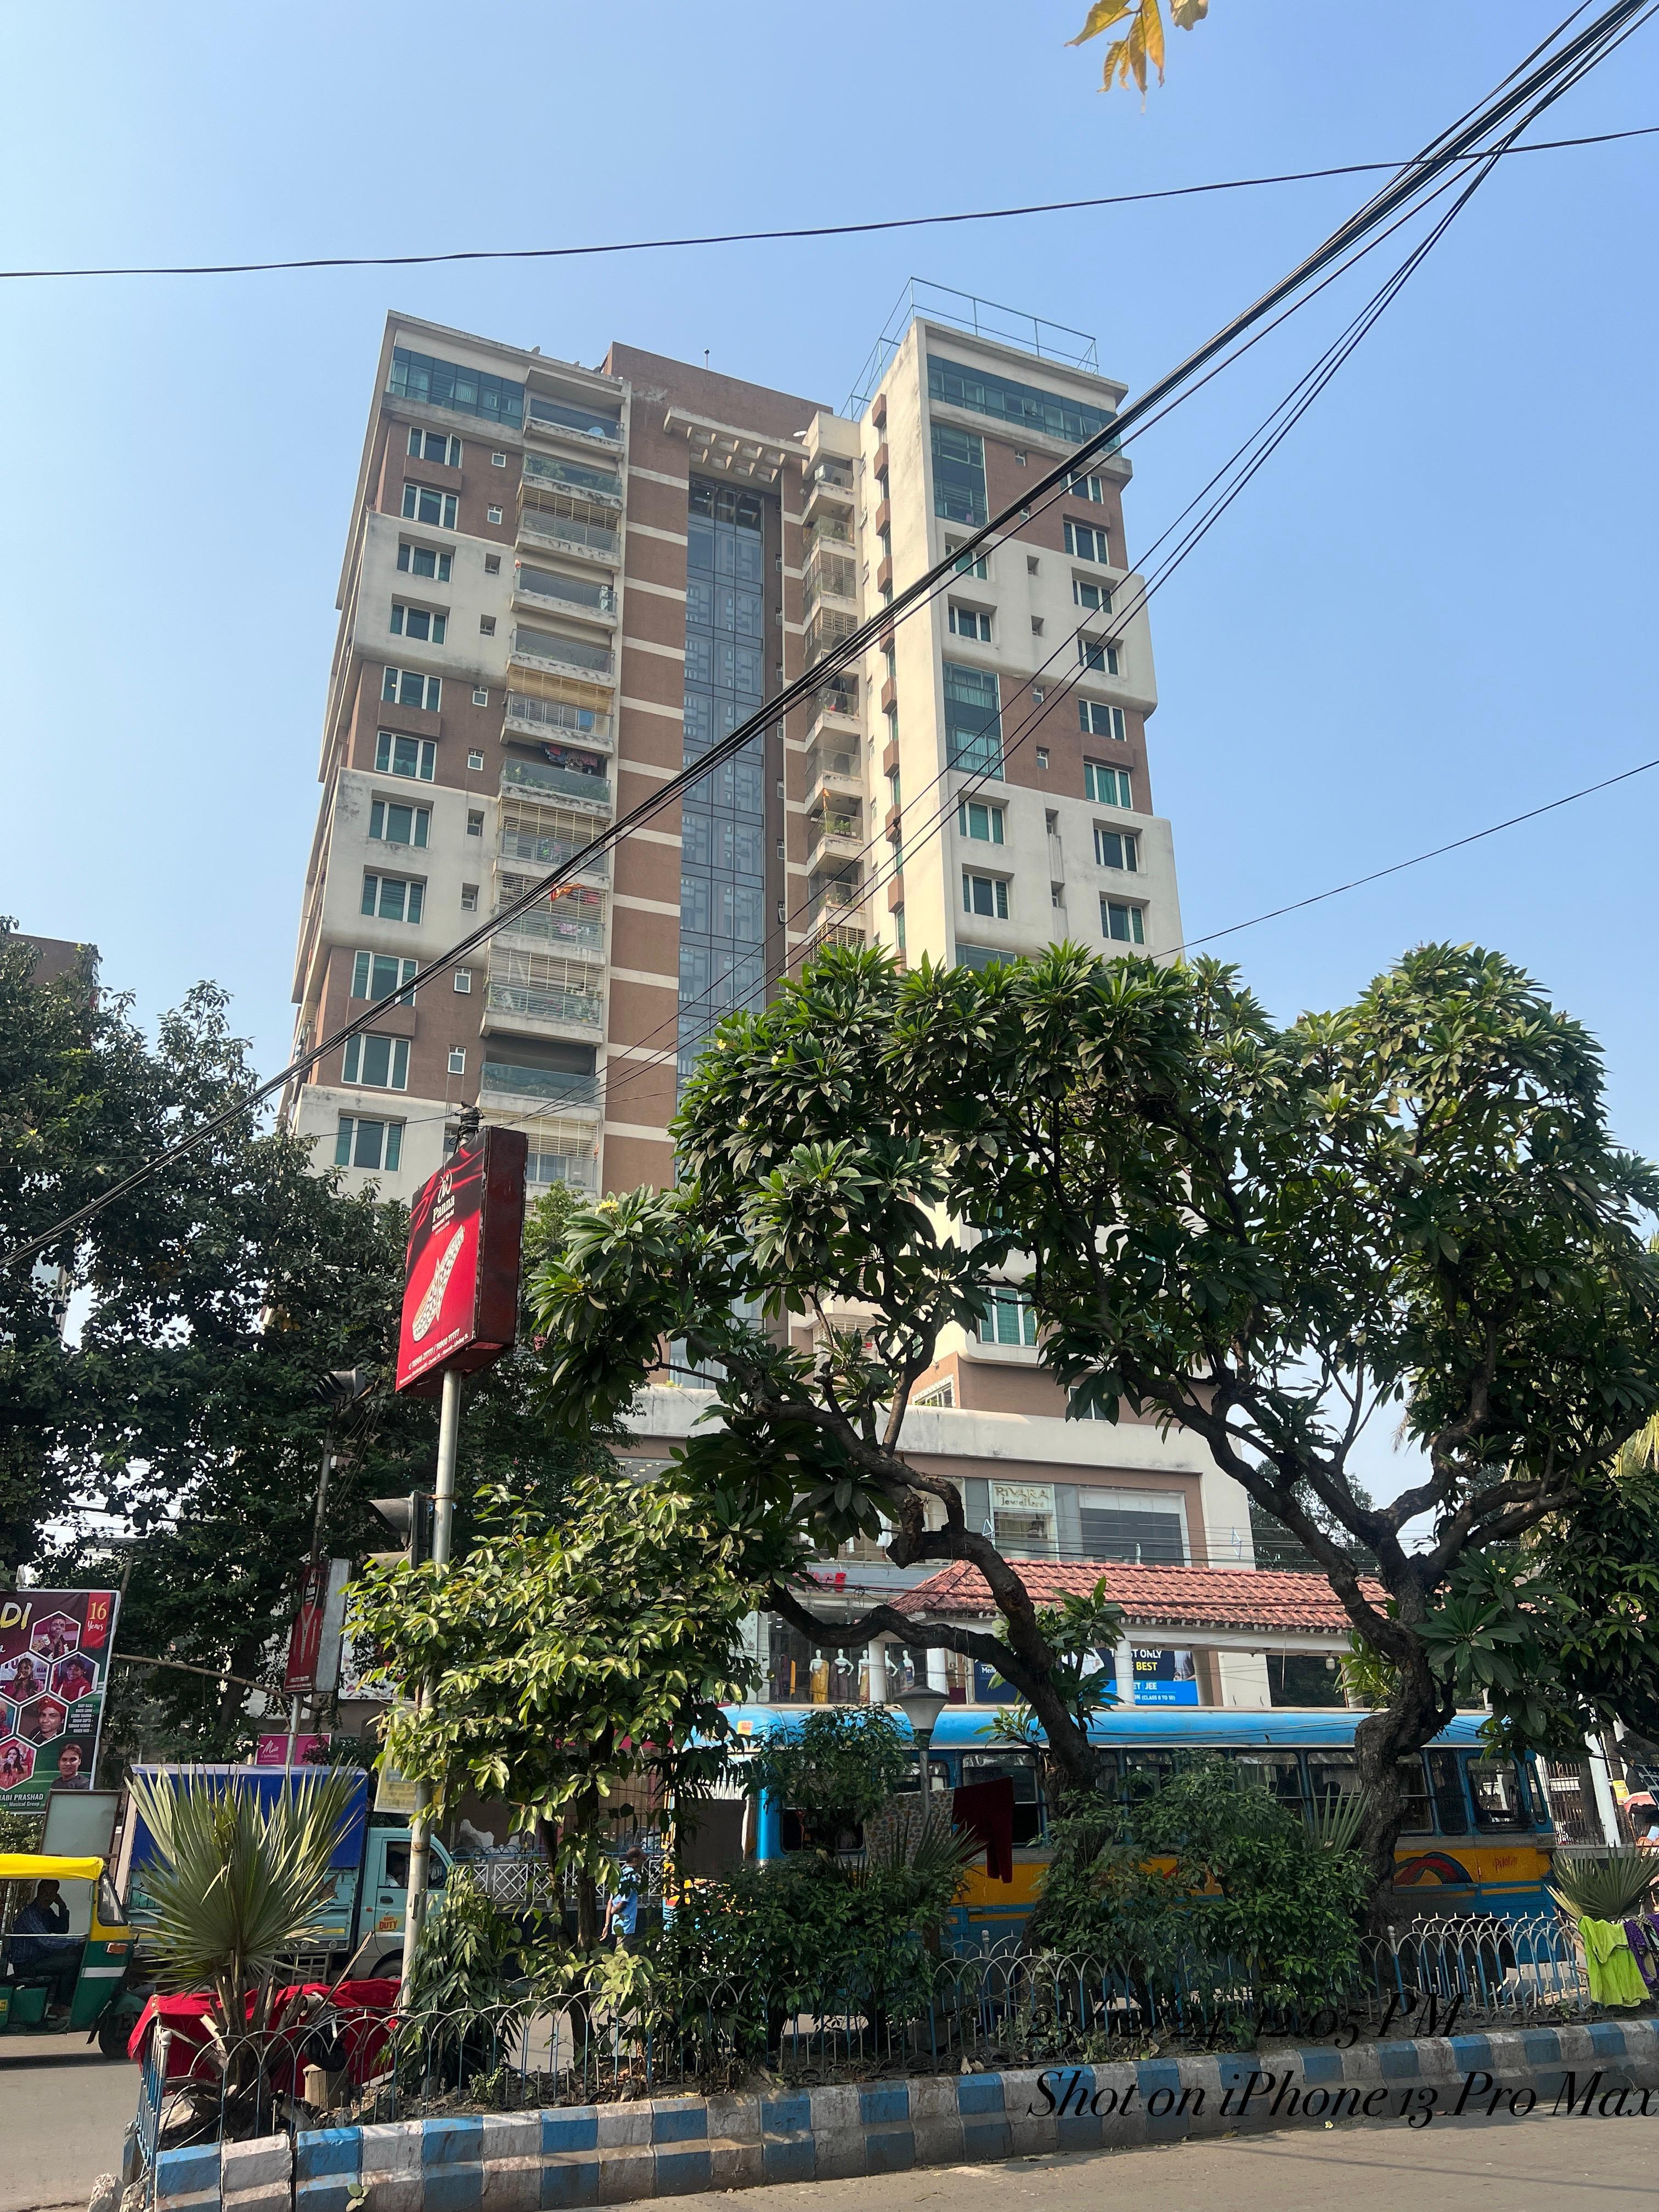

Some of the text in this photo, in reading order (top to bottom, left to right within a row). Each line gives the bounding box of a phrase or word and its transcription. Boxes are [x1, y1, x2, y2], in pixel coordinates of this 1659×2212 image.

[432, 1194, 455, 1223] Panna
[89, 1601, 107, 1620] 16
[87, 1620, 104, 1632] Years
[1139, 1649, 1163, 1658] ONLY
[1136, 1661, 1158, 1671] BEST
[1144, 1681, 1158, 1690] JEE
[379, 1920, 398, 1930] DUTY
